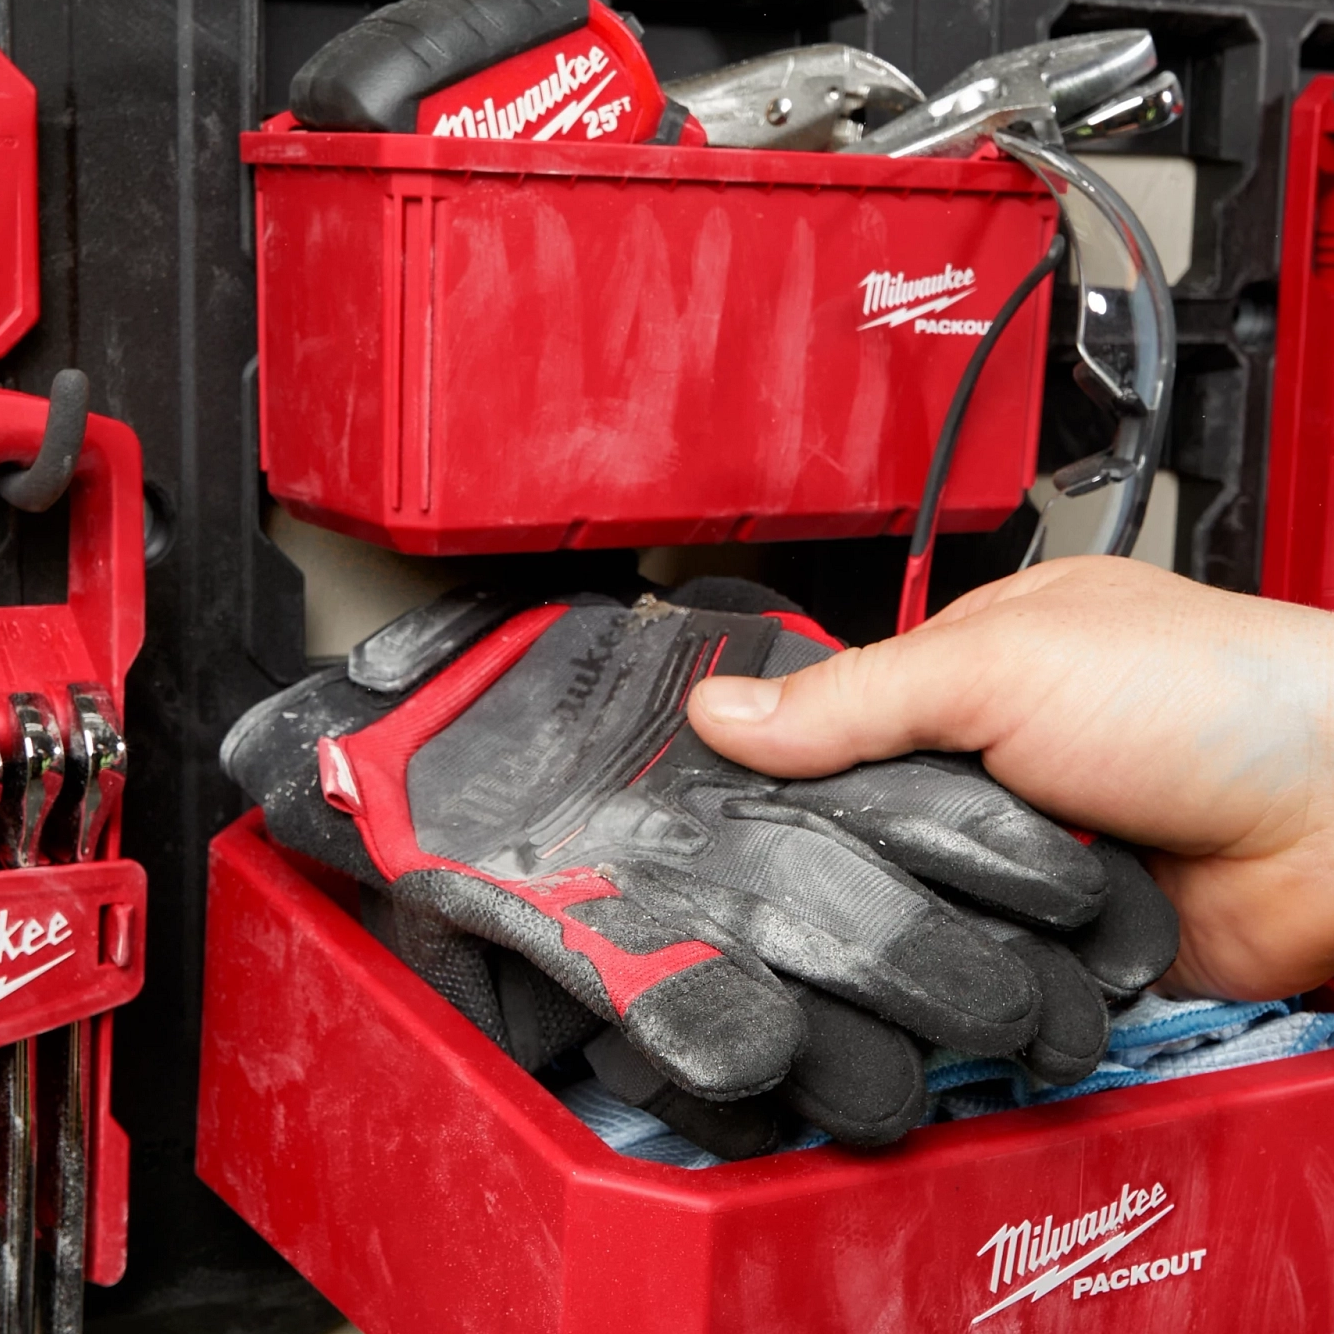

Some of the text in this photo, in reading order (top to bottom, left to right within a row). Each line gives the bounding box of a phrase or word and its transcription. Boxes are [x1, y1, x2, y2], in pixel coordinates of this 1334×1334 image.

[432, 45, 610, 141] Milwaukee
[857, 263, 977, 316] Milwaukee
[914, 319, 993, 336] PACKOU
[976, 1182, 1168, 1293] Milwaukee
[1072, 1248, 1207, 1300] PACKOUT
